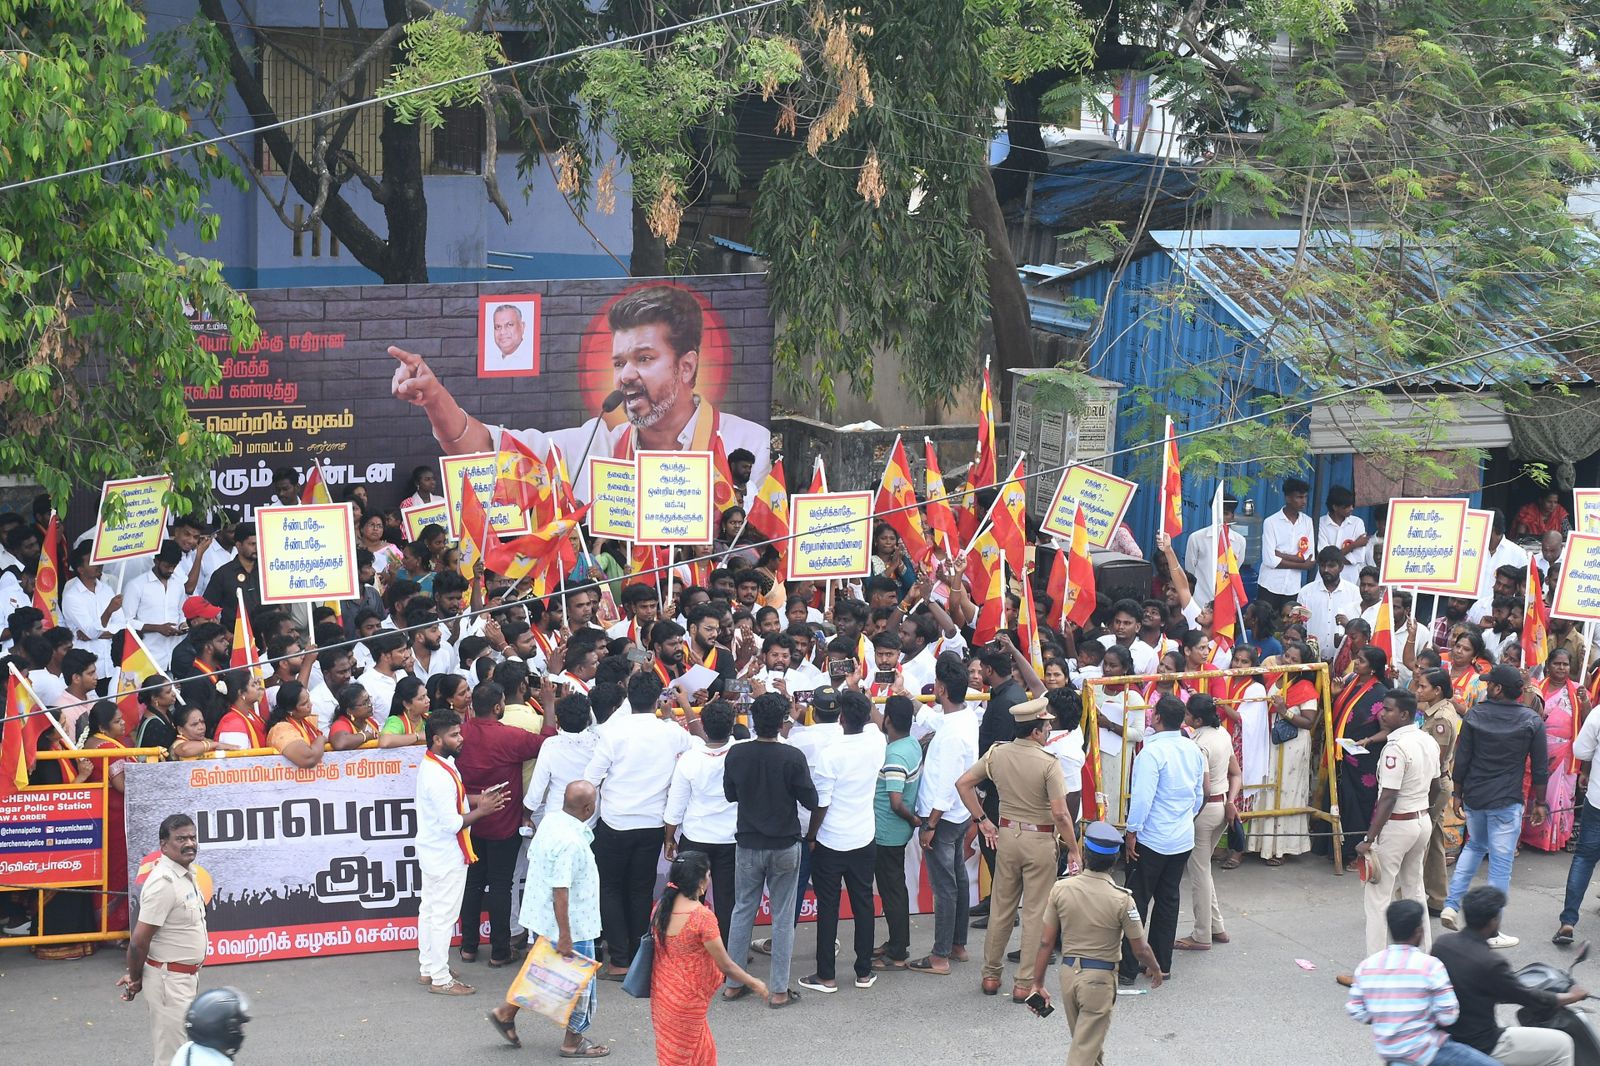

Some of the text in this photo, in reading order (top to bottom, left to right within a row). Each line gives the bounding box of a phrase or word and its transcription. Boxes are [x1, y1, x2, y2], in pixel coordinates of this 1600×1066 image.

[289, 331, 346, 352] எதிரான
[229, 379, 298, 403] கண்டித்து
[206, 408, 354, 436] வெற்றிக் கழகம்
[246, 439, 294, 454] மாவட்டம்
[800, 539, 863, 555] சிறுபான்மையினரை
[269, 555, 344, 573] சகோதரத்துவத்தைச்
[190, 762, 340, 788] இஸ்லாமியர்களுக்கு
[345, 758, 402, 779] எதிரான
[53, 791, 91, 801] POLICE
[24, 804, 54, 812] Police
[57, 802, 92, 811] Station
[0, 826, 42, 836] @chennaipolice
[42, 860, 82, 872] பாதை
[217, 930, 291, 958] வெற்றிக்
[295, 925, 351, 954] கழகம்
